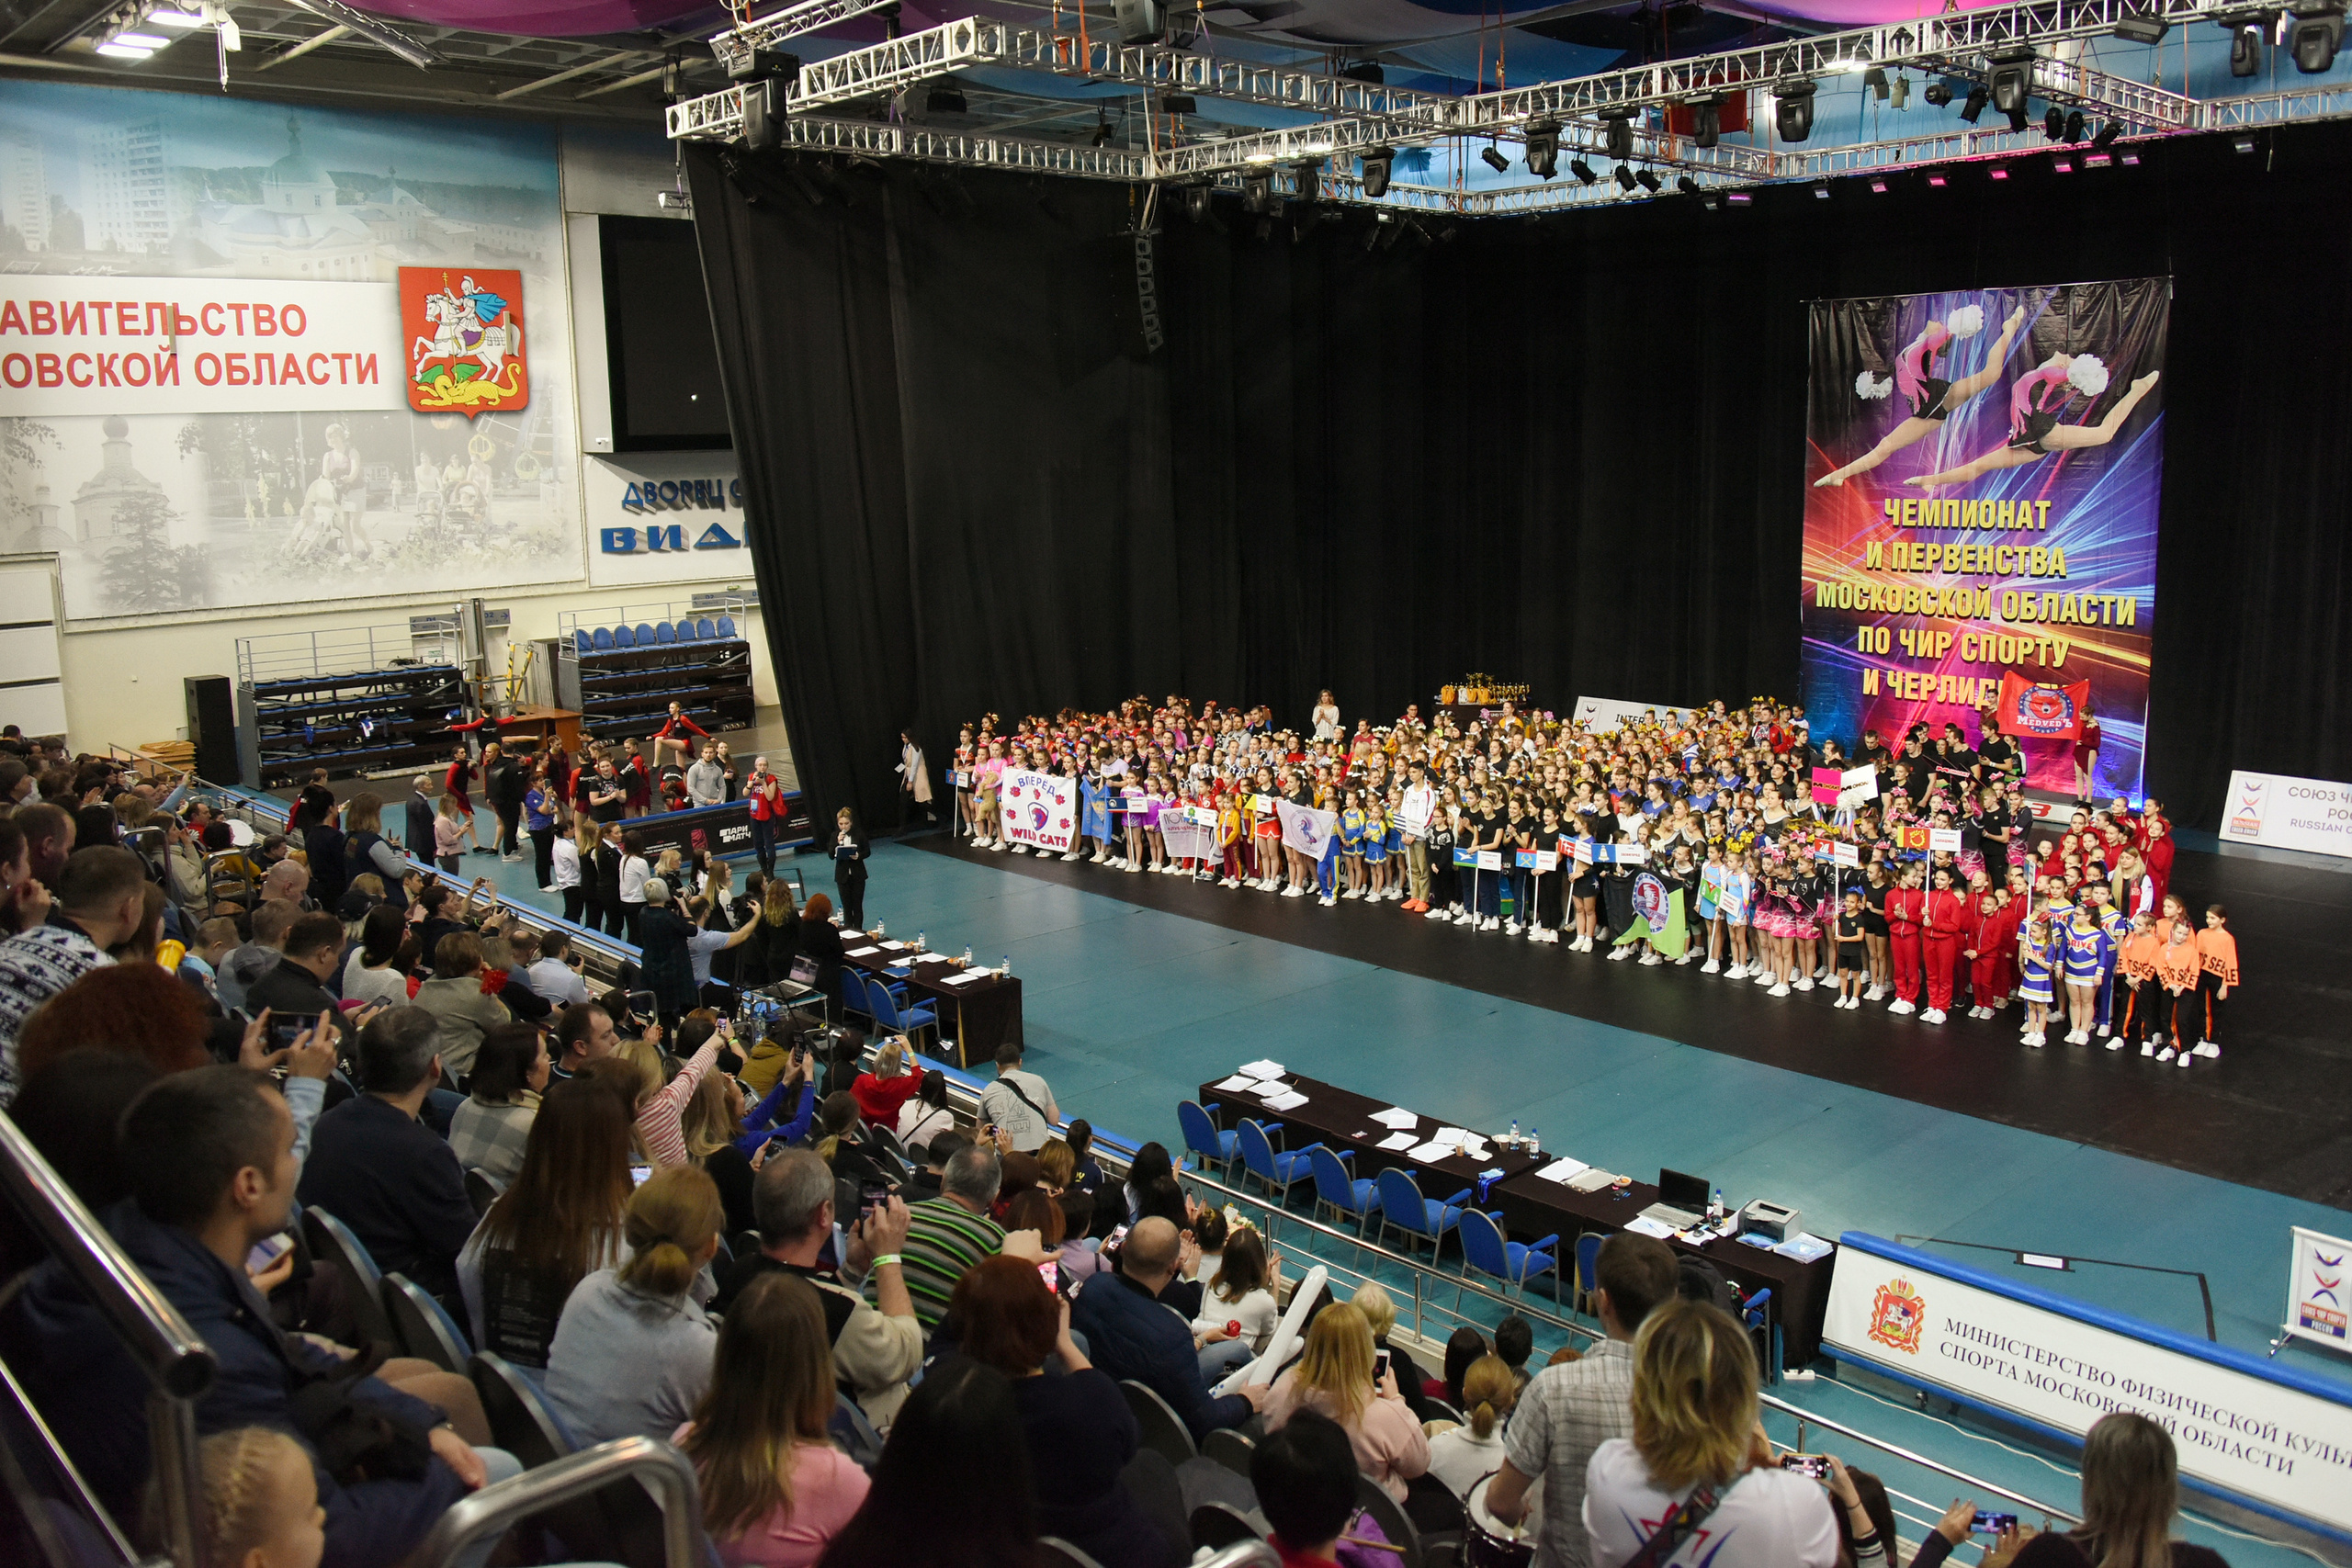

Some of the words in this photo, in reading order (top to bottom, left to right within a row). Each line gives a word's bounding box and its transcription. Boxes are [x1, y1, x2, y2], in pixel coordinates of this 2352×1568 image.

[0, 344, 180, 388] ОВСКОЙ
[195, 353, 379, 388] ОБЛАСТИ
[622, 479, 726, 511] ДВОРЕЦ
[1884, 499, 2051, 529] ЧЕМПИОНАТ
[1866, 541, 1883, 568] И
[1892, 542, 2066, 576] ПЕРВЕНСТВА
[1816, 581, 1991, 618] МОСКОВСКОЙ
[2002, 591, 2136, 626] ОБЛАСТИ
[1859, 626, 1890, 654] ПО
[1899, 629, 1951, 659] ЧИР
[1962, 635, 2071, 668] СПОРТУ
[1863, 668, 1879, 695] И
[1017, 775, 1055, 797] ВПЕРЁД
[2288, 786, 2335, 802] СОЮЗ
[2290, 818, 2343, 833] RUSSIAN
[2328, 808, 2352, 820] РО
[1010, 828, 1036, 841] WILD
[1039, 833, 1068, 847] CATS
[2301, 1304, 2316, 1315] СОЮЗ
[2316, 1308, 2327, 1319] ЧИР
[2327, 1312, 2346, 1325] СПОРТА
[2311, 1320, 2334, 1334] РОССИИ
[1944, 1318, 2116, 1388] МИНИСТЕРСТВО
[2121, 1378, 2278, 1444] ФИЗИЧЕСКОЙ
[1939, 1341, 2018, 1382] СПОРТА
[2183, 1425, 2294, 1476] ОБЛАСТИ
